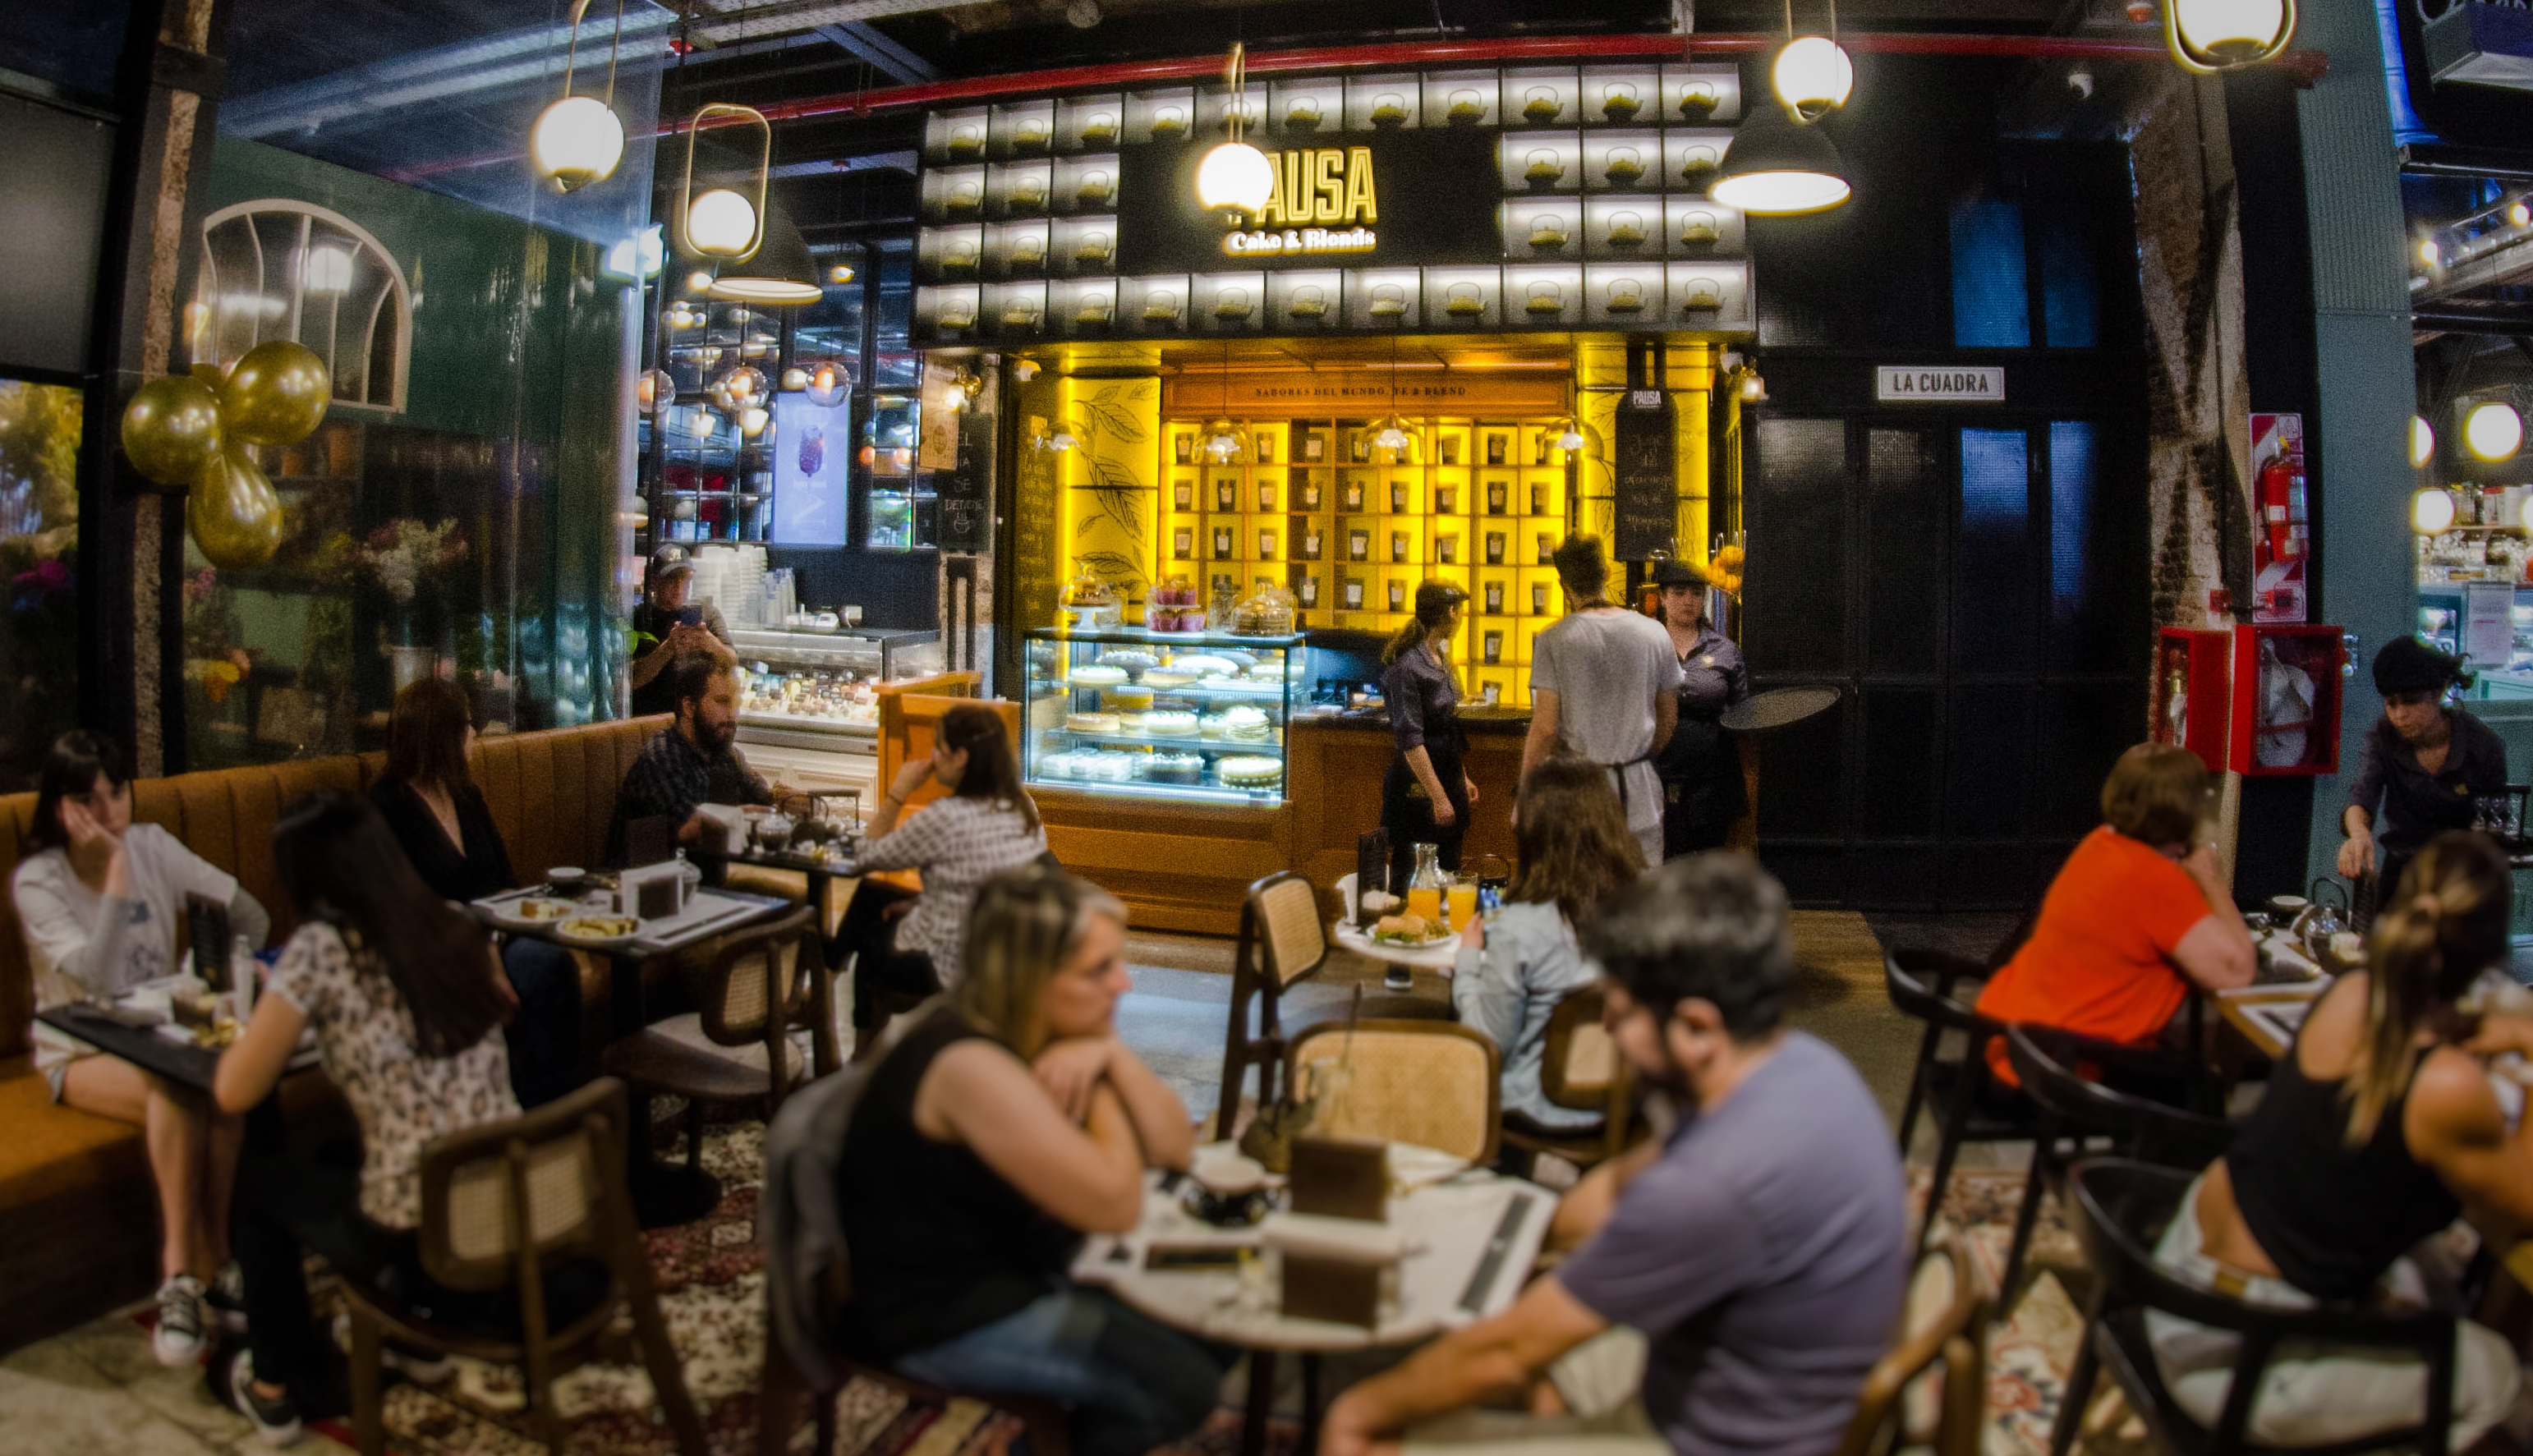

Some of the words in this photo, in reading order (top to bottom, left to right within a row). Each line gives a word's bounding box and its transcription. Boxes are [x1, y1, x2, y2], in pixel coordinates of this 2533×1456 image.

[1228, 146, 1377, 225] AUSA
[1231, 230, 1282, 250] Cake
[1284, 230, 1303, 249] &
[1305, 227, 1377, 247] Blends
[1256, 388, 1310, 397] SABORES
[1314, 388, 1336, 397] DEL
[1892, 373, 1914, 393] LA
[1919, 373, 1989, 393] CUADRA
[1633, 390, 1662, 405] PAUSA
